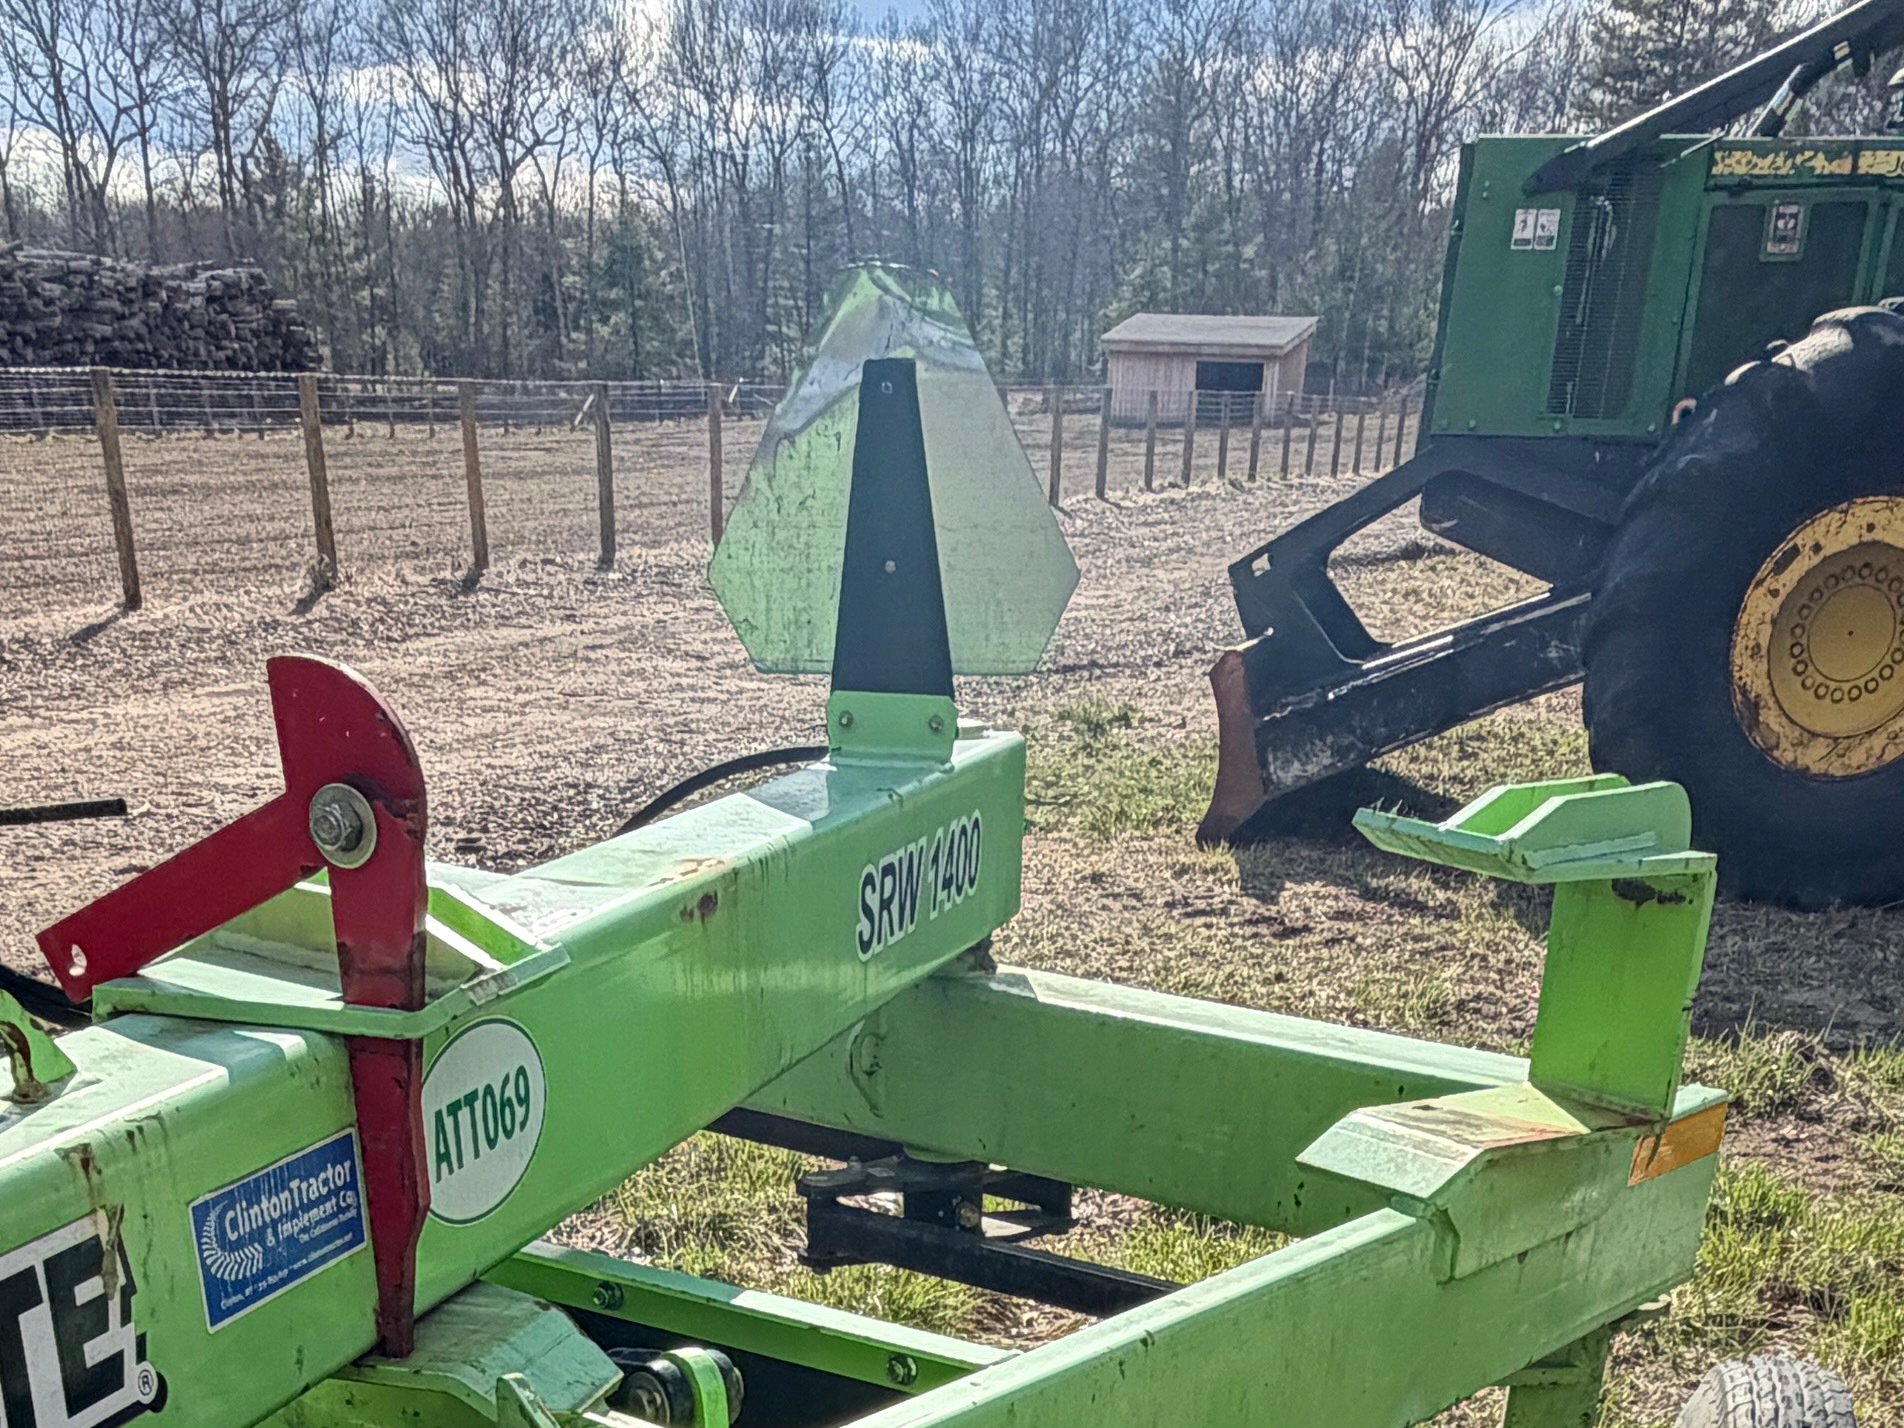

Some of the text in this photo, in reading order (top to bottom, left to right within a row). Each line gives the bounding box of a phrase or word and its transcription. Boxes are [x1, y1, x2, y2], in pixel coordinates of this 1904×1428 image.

[858, 815, 981, 956] SRW 1400
[434, 1065, 530, 1184] ATT069
